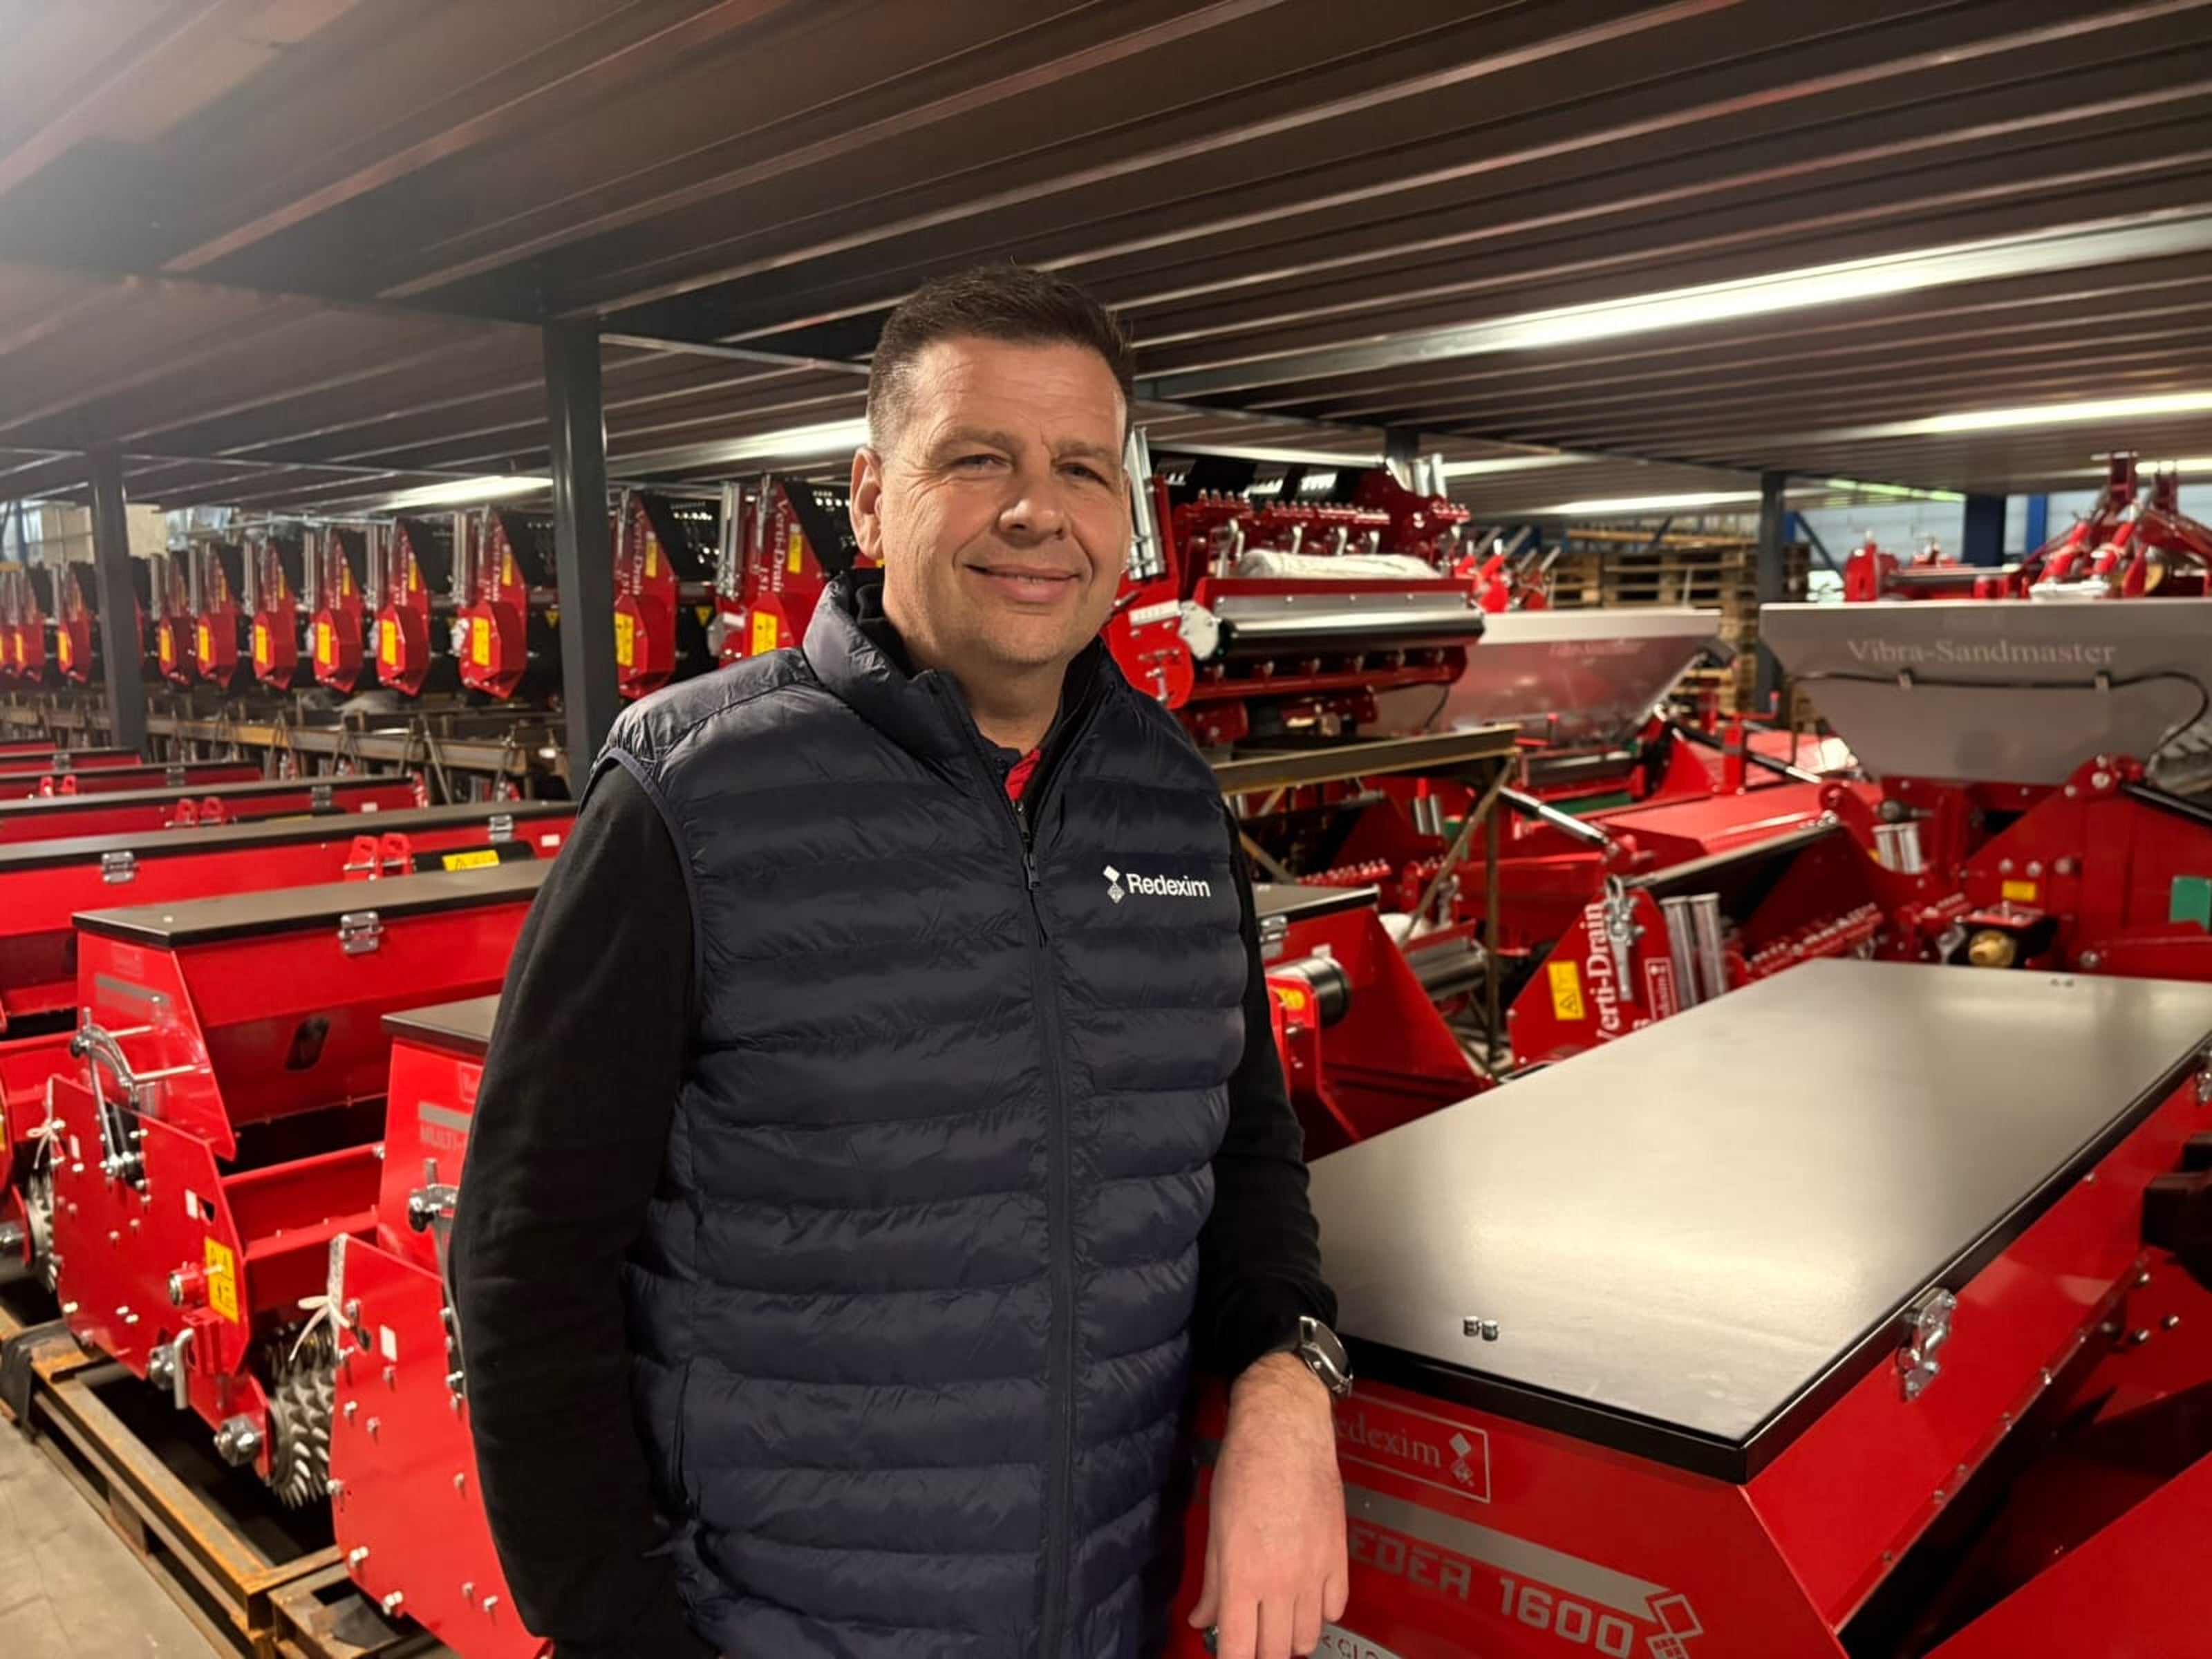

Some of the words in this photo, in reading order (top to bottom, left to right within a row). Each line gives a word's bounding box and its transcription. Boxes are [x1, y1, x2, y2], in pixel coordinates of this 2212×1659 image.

[1847, 639, 2117, 664] Vibra-Sandmaster
[1125, 872, 1211, 897] Redexim
[1337, 1411, 1441, 1468] edexim
[1348, 1525, 1472, 1601] EDER
[1499, 1576, 1633, 1659] 1600
